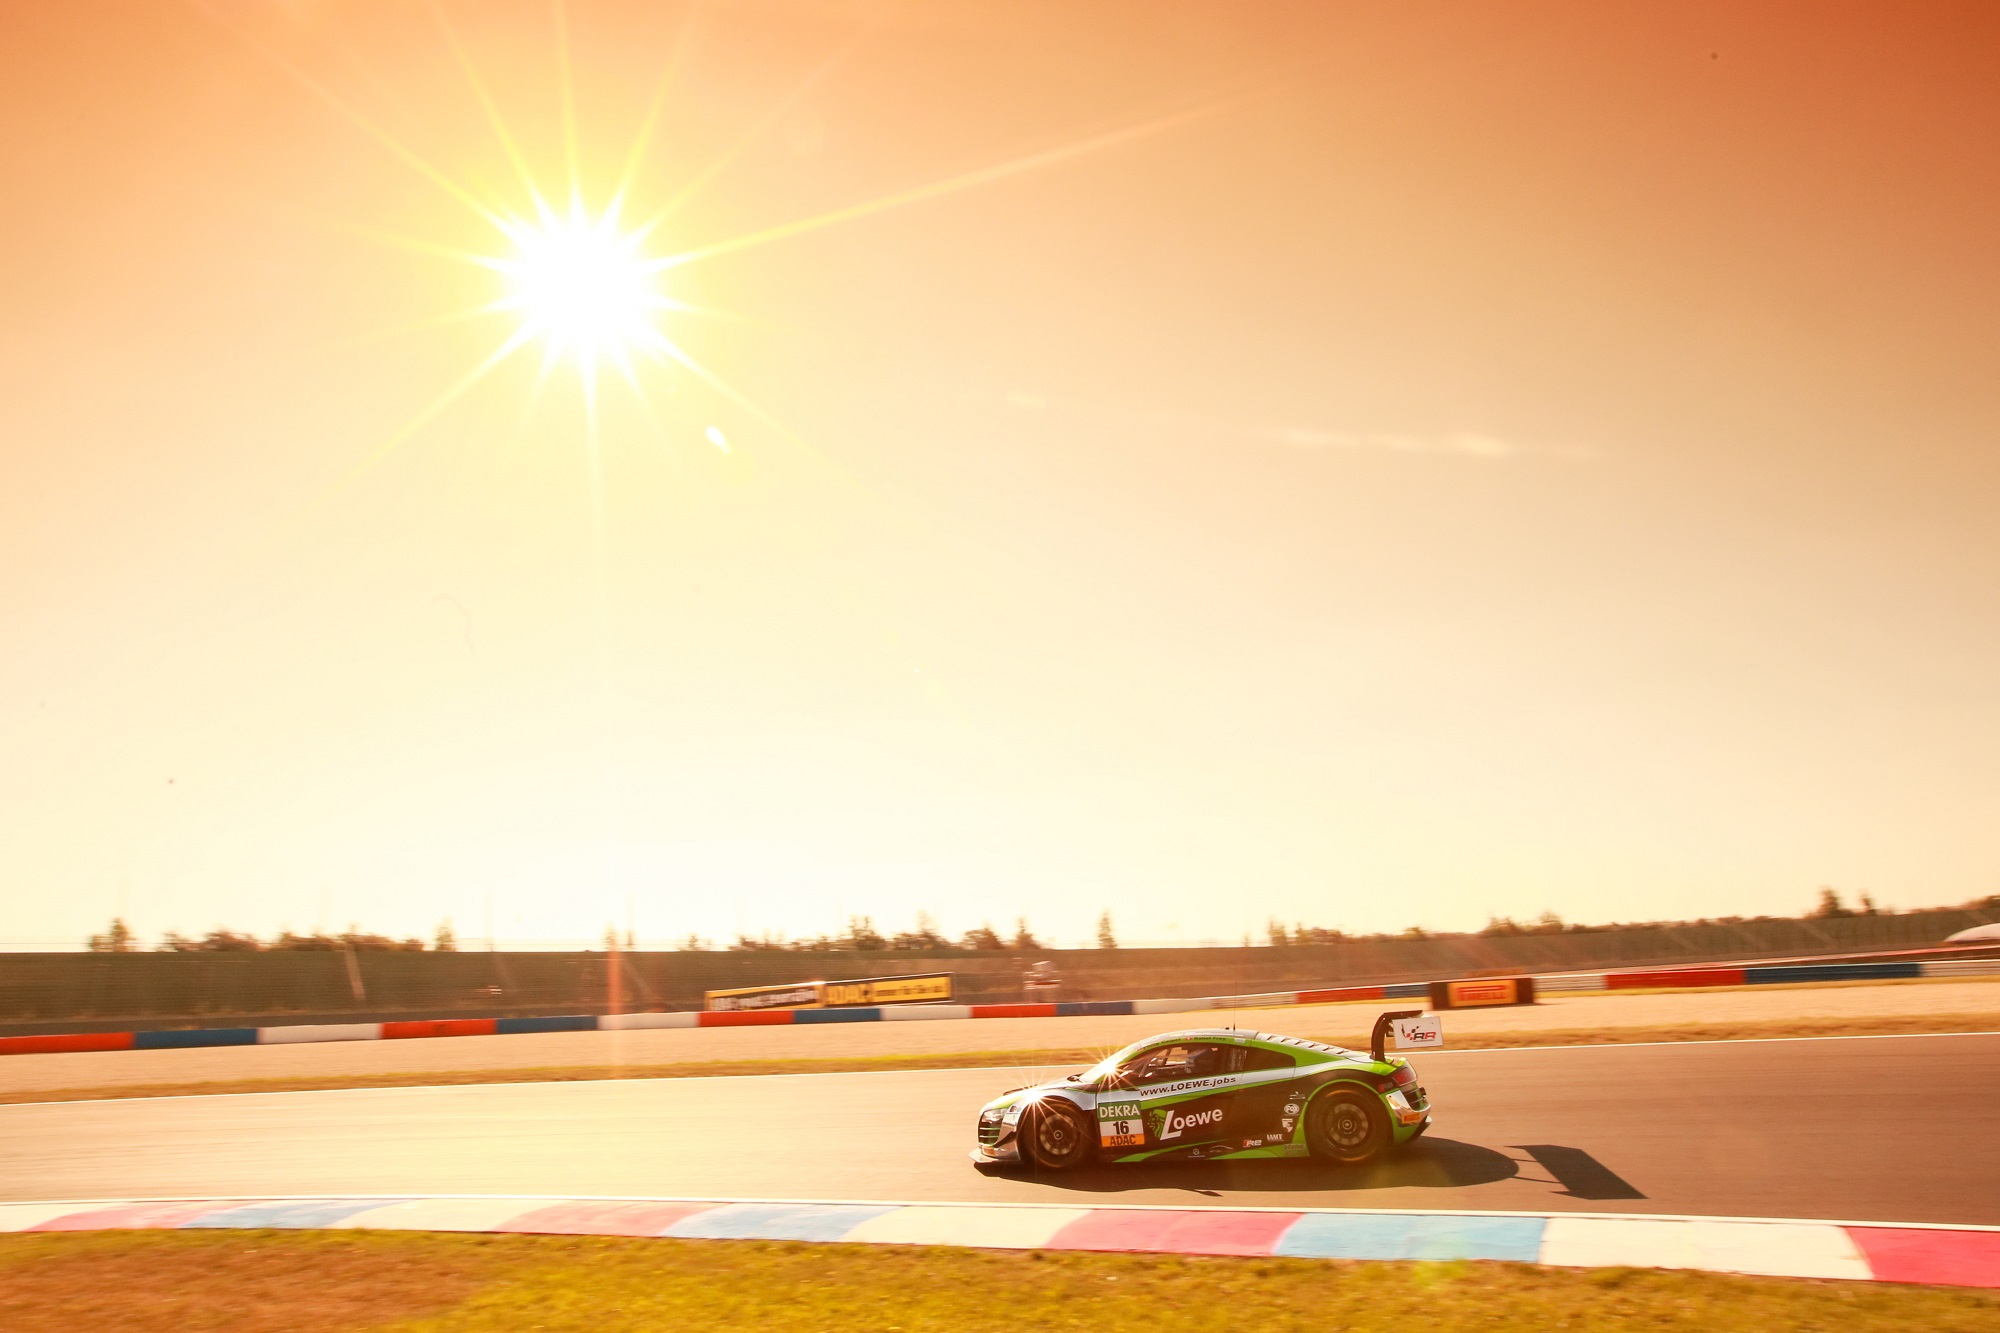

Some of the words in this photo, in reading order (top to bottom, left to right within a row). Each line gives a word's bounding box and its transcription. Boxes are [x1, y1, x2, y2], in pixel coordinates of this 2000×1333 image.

[1140, 1077, 1236, 1096] www.LOEWE.jobs
[1099, 1104, 1140, 1118] DEKRA
[1112, 1120, 1130, 1135] 16
[1160, 1108, 1223, 1140] Loewe
[1109, 1134, 1137, 1147] ADAC
